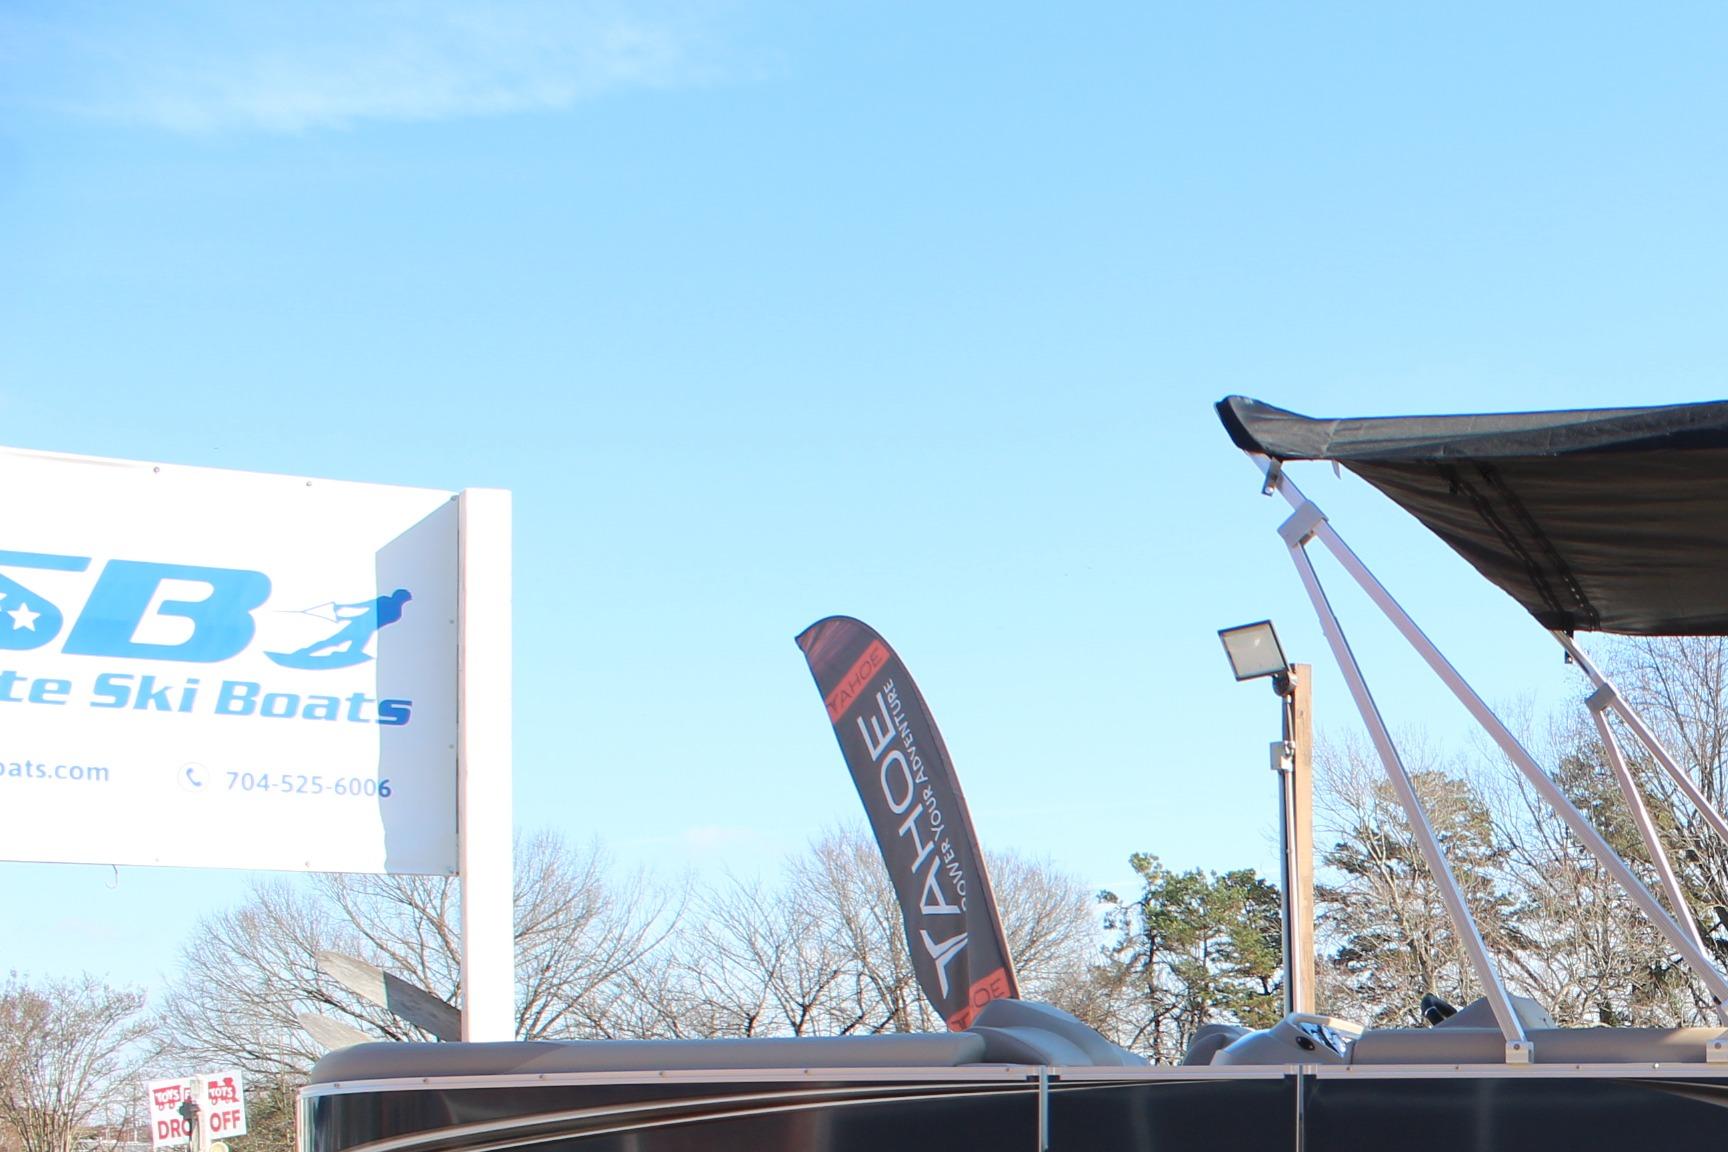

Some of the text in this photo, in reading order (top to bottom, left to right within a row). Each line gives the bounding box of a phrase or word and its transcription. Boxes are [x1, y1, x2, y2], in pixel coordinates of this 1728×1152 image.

[90, 672, 200, 713] Ski
[214, 679, 413, 727] Boats
[828, 646, 883, 714] TAHOE
[883, 678, 929, 784] ADVENTURE
[226, 770, 392, 799] 704-525-6006
[922, 785, 945, 842] YOUR
[857, 691, 968, 999] TAHOE
[155, 1088, 180, 1103] TOYS
[209, 1086, 233, 1098] TOTS
[157, 1110, 241, 1140] DRO OFF
